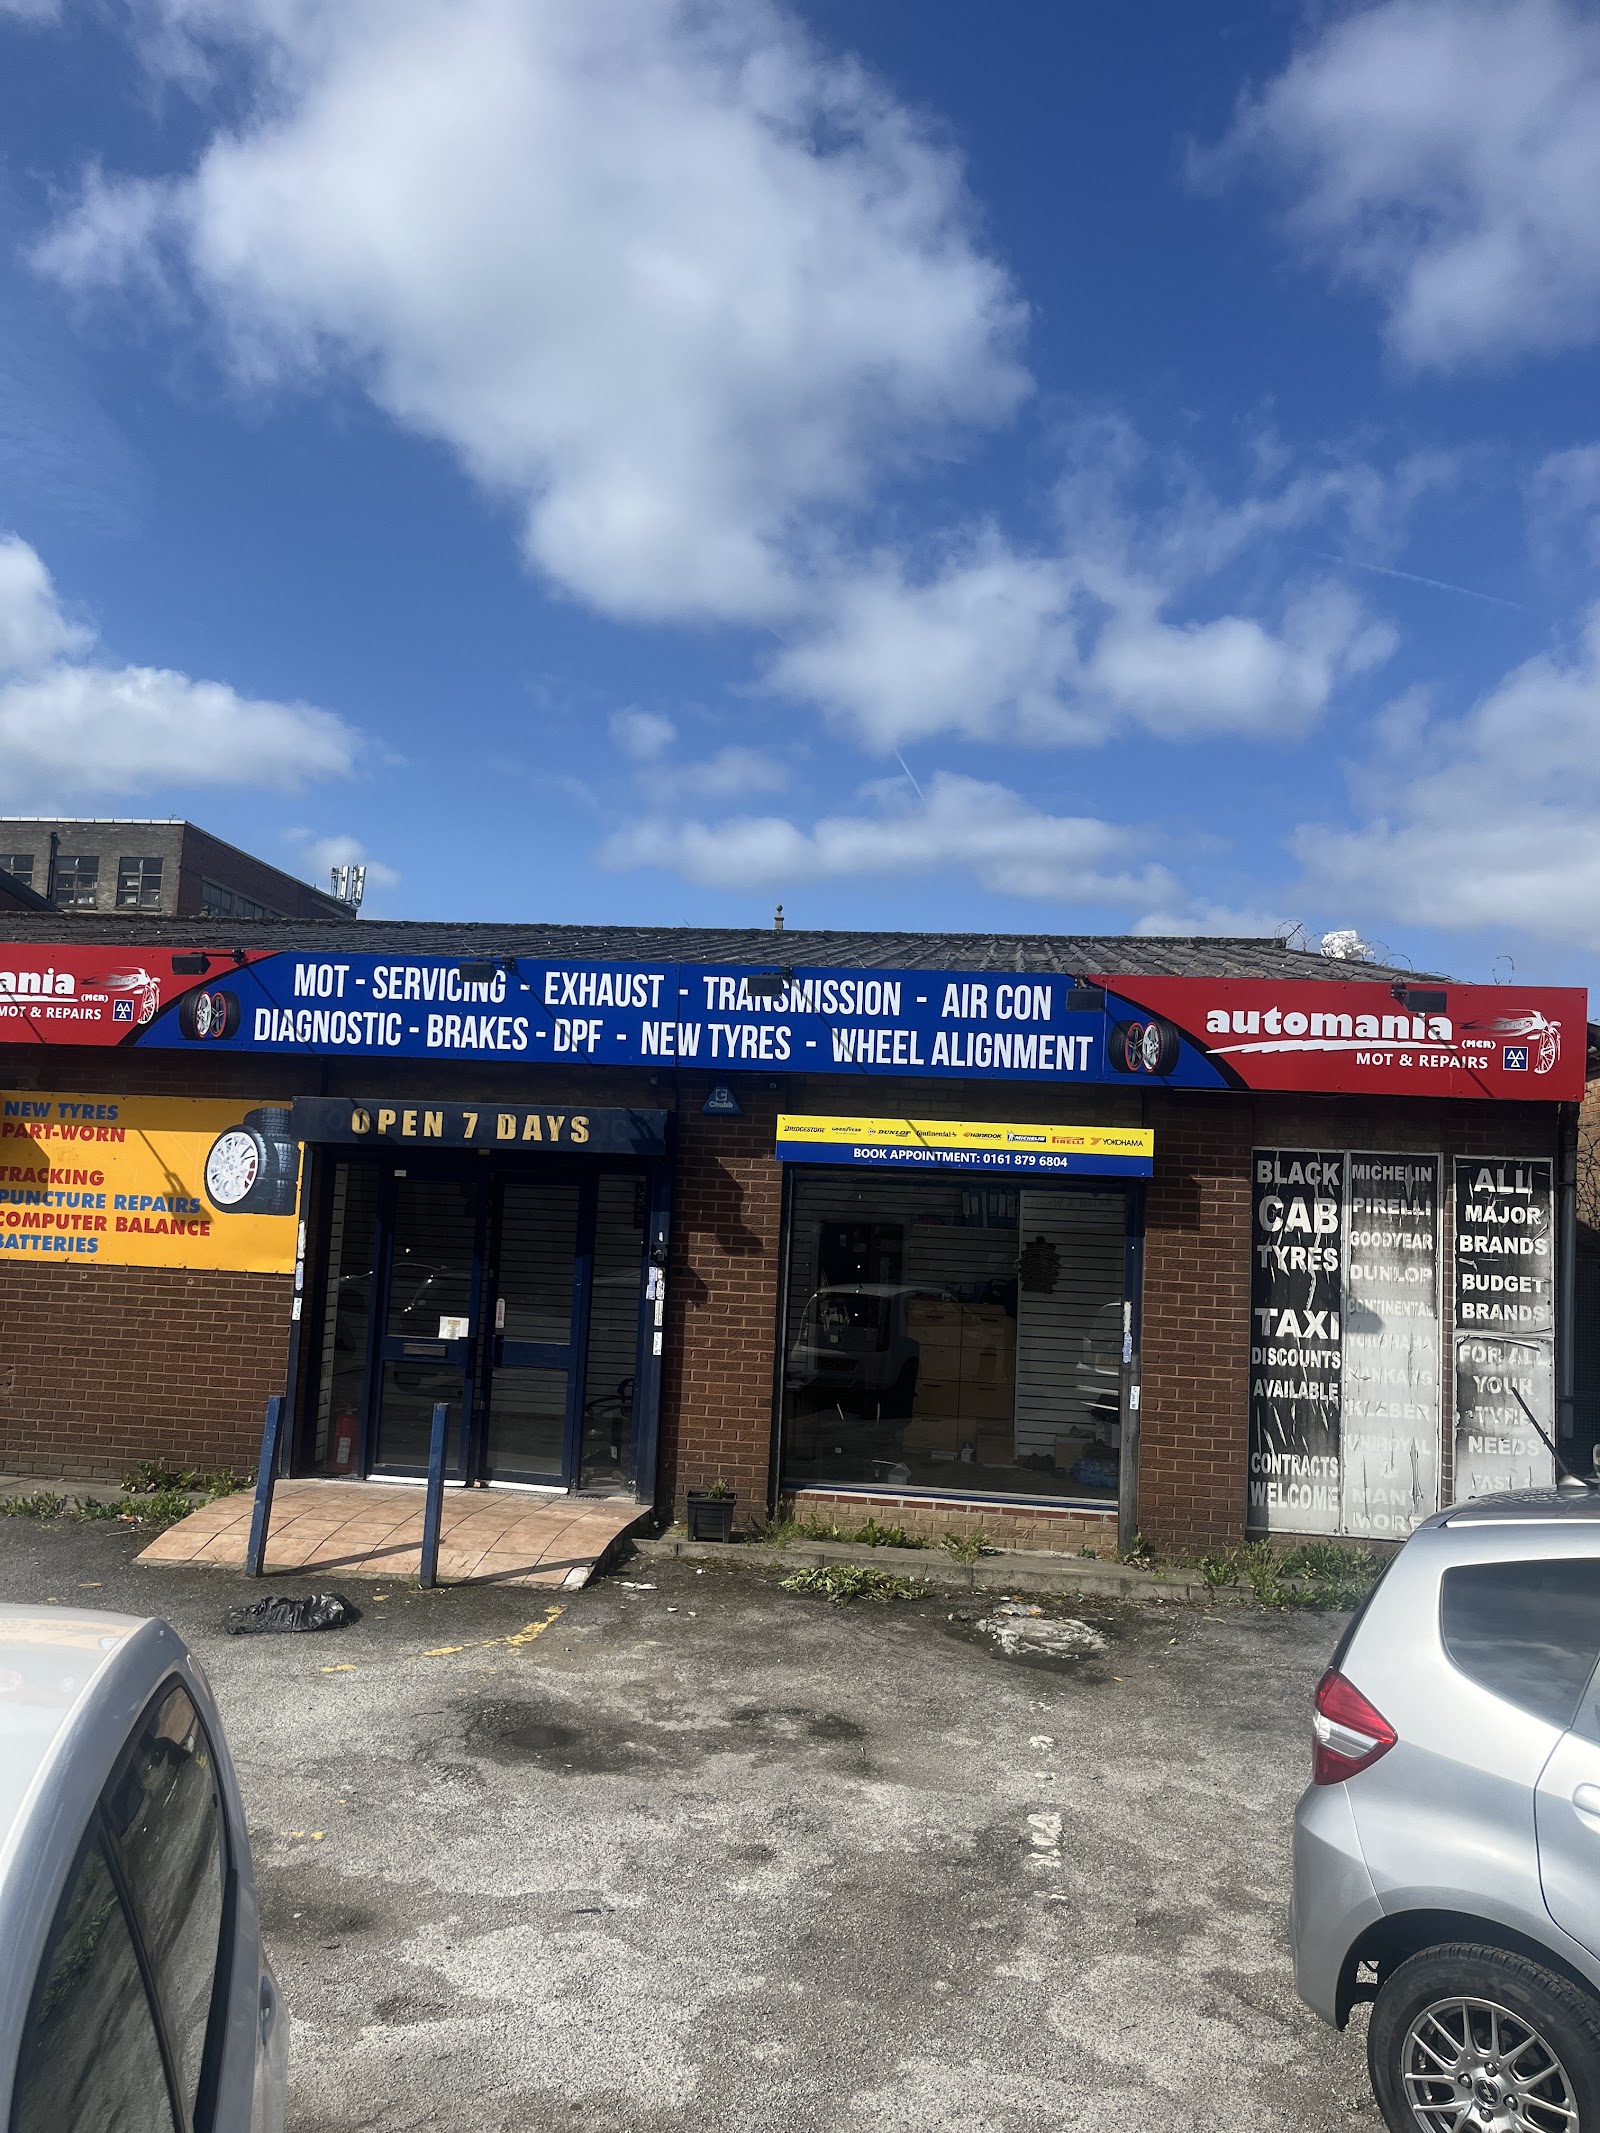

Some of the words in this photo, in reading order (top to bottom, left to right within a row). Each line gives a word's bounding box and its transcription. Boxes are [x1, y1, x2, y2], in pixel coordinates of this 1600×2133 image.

[294, 964, 350, 997] MOT
[545, 971, 664, 1008] EXHAUST
[942, 984, 987, 1018] AIR
[996, 984, 1051, 1021] CON
[30, 1007, 41, 1018] &
[46, 1007, 101, 1020] REPAIRS
[1206, 1006, 1452, 1040] automania
[254, 1008, 402, 1046] DIAGNOSTIC
[427, 1014, 527, 1051] BRAKES
[553, 1018, 603, 1052] DPF
[641, 1021, 701, 1056] NEW
[708, 1024, 792, 1060] TYRES
[832, 1027, 925, 1065] WHEEL
[931, 1031, 1094, 1071] ALIGNMENT
[1461, 1040, 1496, 1050] (MCR)
[1356, 1052, 1393, 1066] MOT
[1399, 1054, 1413, 1066] &
[1419, 1055, 1488, 1069] REPAIRS
[4, 1100, 51, 1117] NEW
[58, 1103, 119, 1121] TYRES
[2, 1122, 125, 1142] PART-WORN
[351, 1108, 443, 1138] OPEN
[462, 1112, 479, 1140] 7
[497, 1114, 591, 1143] DAYS
[1052, 1136, 1085, 1145] PIRELLI
[1103, 1138, 1143, 1147] YOKOHAMA
[854, 1148, 887, 1160] BOOK
[890, 1150, 980, 1163] APPOINTMENT:
[983, 1153, 1011, 1164] 0161
[1014, 1155, 1036, 1166] 879
[1039, 1156, 1068, 1167] 6804
[0, 1166, 105, 1186] TRACKING
[1257, 1161, 1340, 1186] BLACK
[1352, 1164, 1432, 1182] MICHELIN
[1474, 1168, 1532, 1194] ALL
[0, 1189, 106, 1209] PUNCTURE
[114, 1194, 201, 1213] REPAIRS
[1353, 1198, 1431, 1216] PIRELLI
[1259, 1195, 1339, 1233] CAB
[1465, 1204, 1541, 1225] MAJOR
[116, 1216, 211, 1236] BALANCE
[1350, 1232, 1433, 1250] GOODYEAR
[1460, 1235, 1548, 1255] BRANDS
[1257, 1245, 1338, 1272] TYRES
[1350, 1265, 1432, 1283] DUNLOP
[1462, 1274, 1545, 1293] BUDGET
[1347, 1299, 1433, 1317] CONTINENTAL
[1462, 1302, 1545, 1322] BRANDS
[1255, 1308, 1340, 1340] TAXI
[1252, 1347, 1341, 1369] DISCOUNTS
[1459, 1345, 1502, 1363] FOR
[1253, 1378, 1339, 1400] AVAILABLE
[1473, 1376, 1533, 1395] YOUR
[1468, 1436, 1540, 1456] NEEDS
[1251, 1452, 1339, 1478] CONTRACTS
[1251, 1482, 1338, 1512] WELCOME
